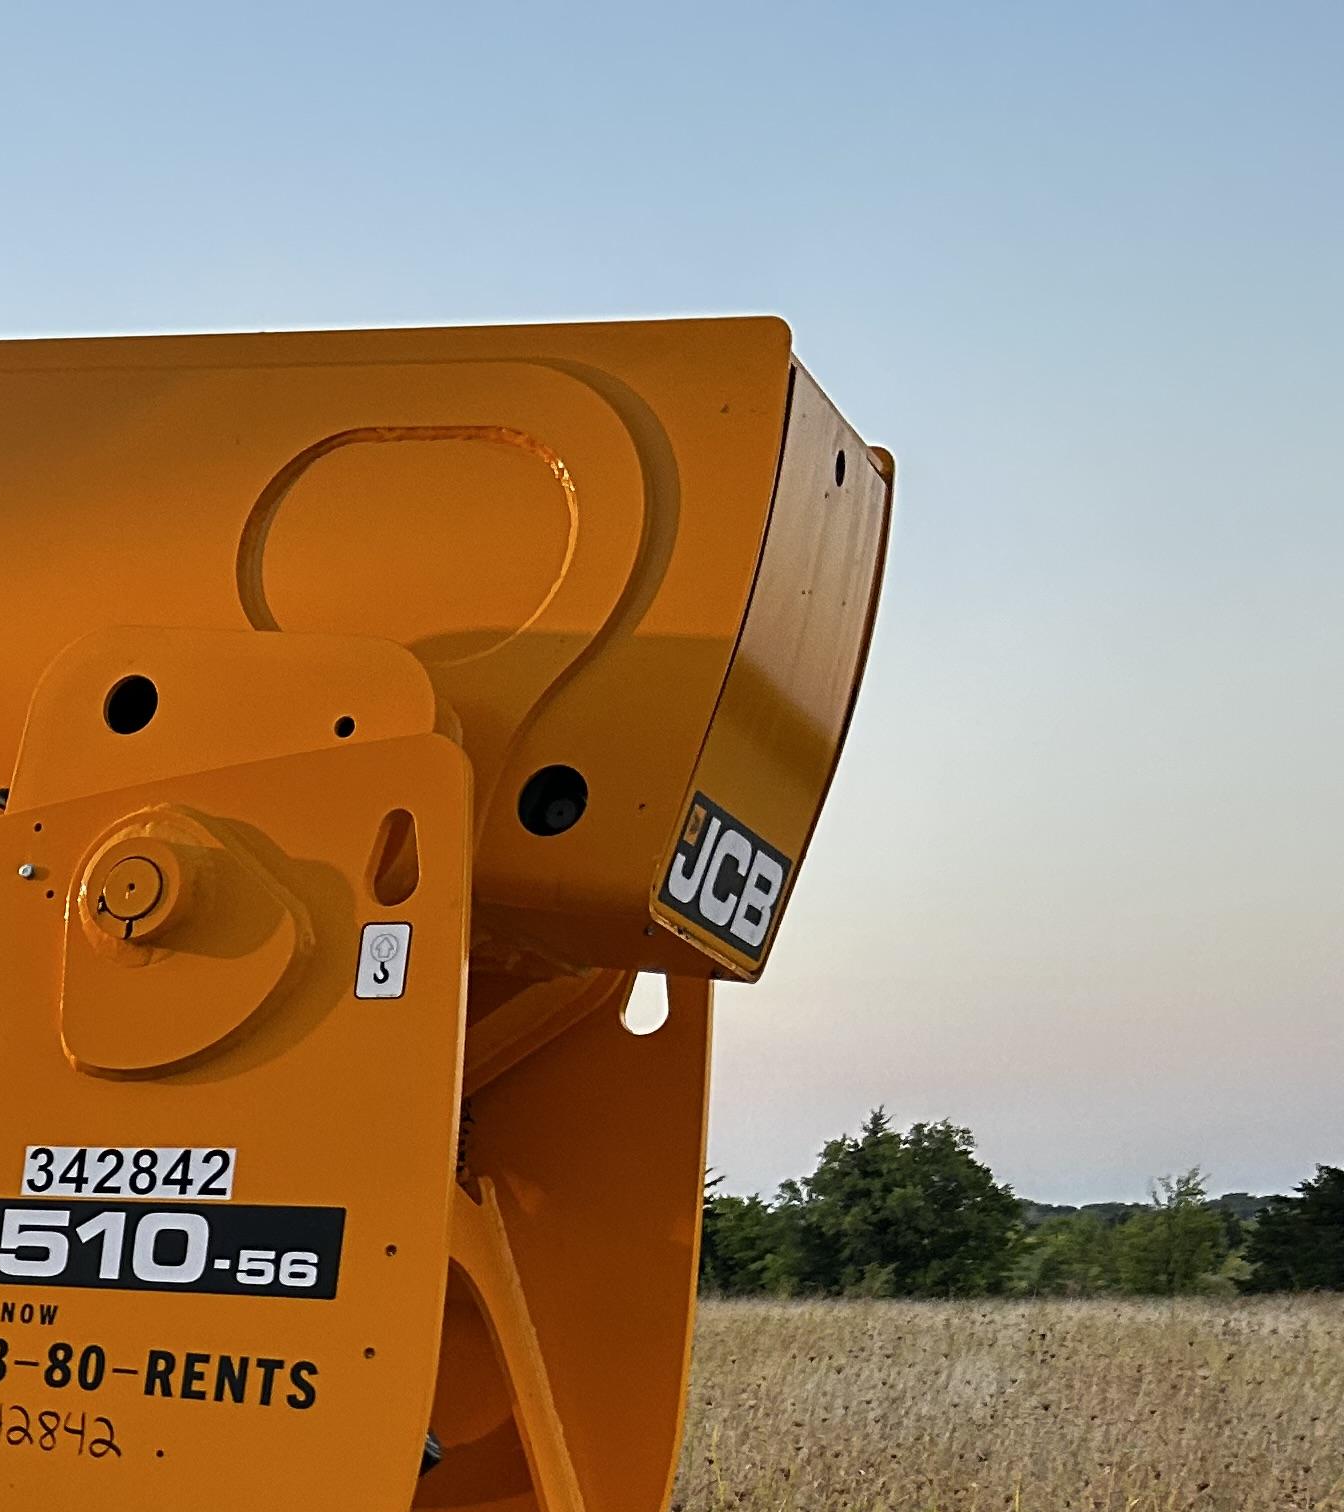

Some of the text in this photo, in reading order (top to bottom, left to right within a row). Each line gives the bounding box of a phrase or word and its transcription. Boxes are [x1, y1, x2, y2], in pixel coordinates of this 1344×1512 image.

[668, 816, 784, 947] JCB
[25, 1147, 232, 1196] 342842
[0, 1303, 60, 1326] NOW
